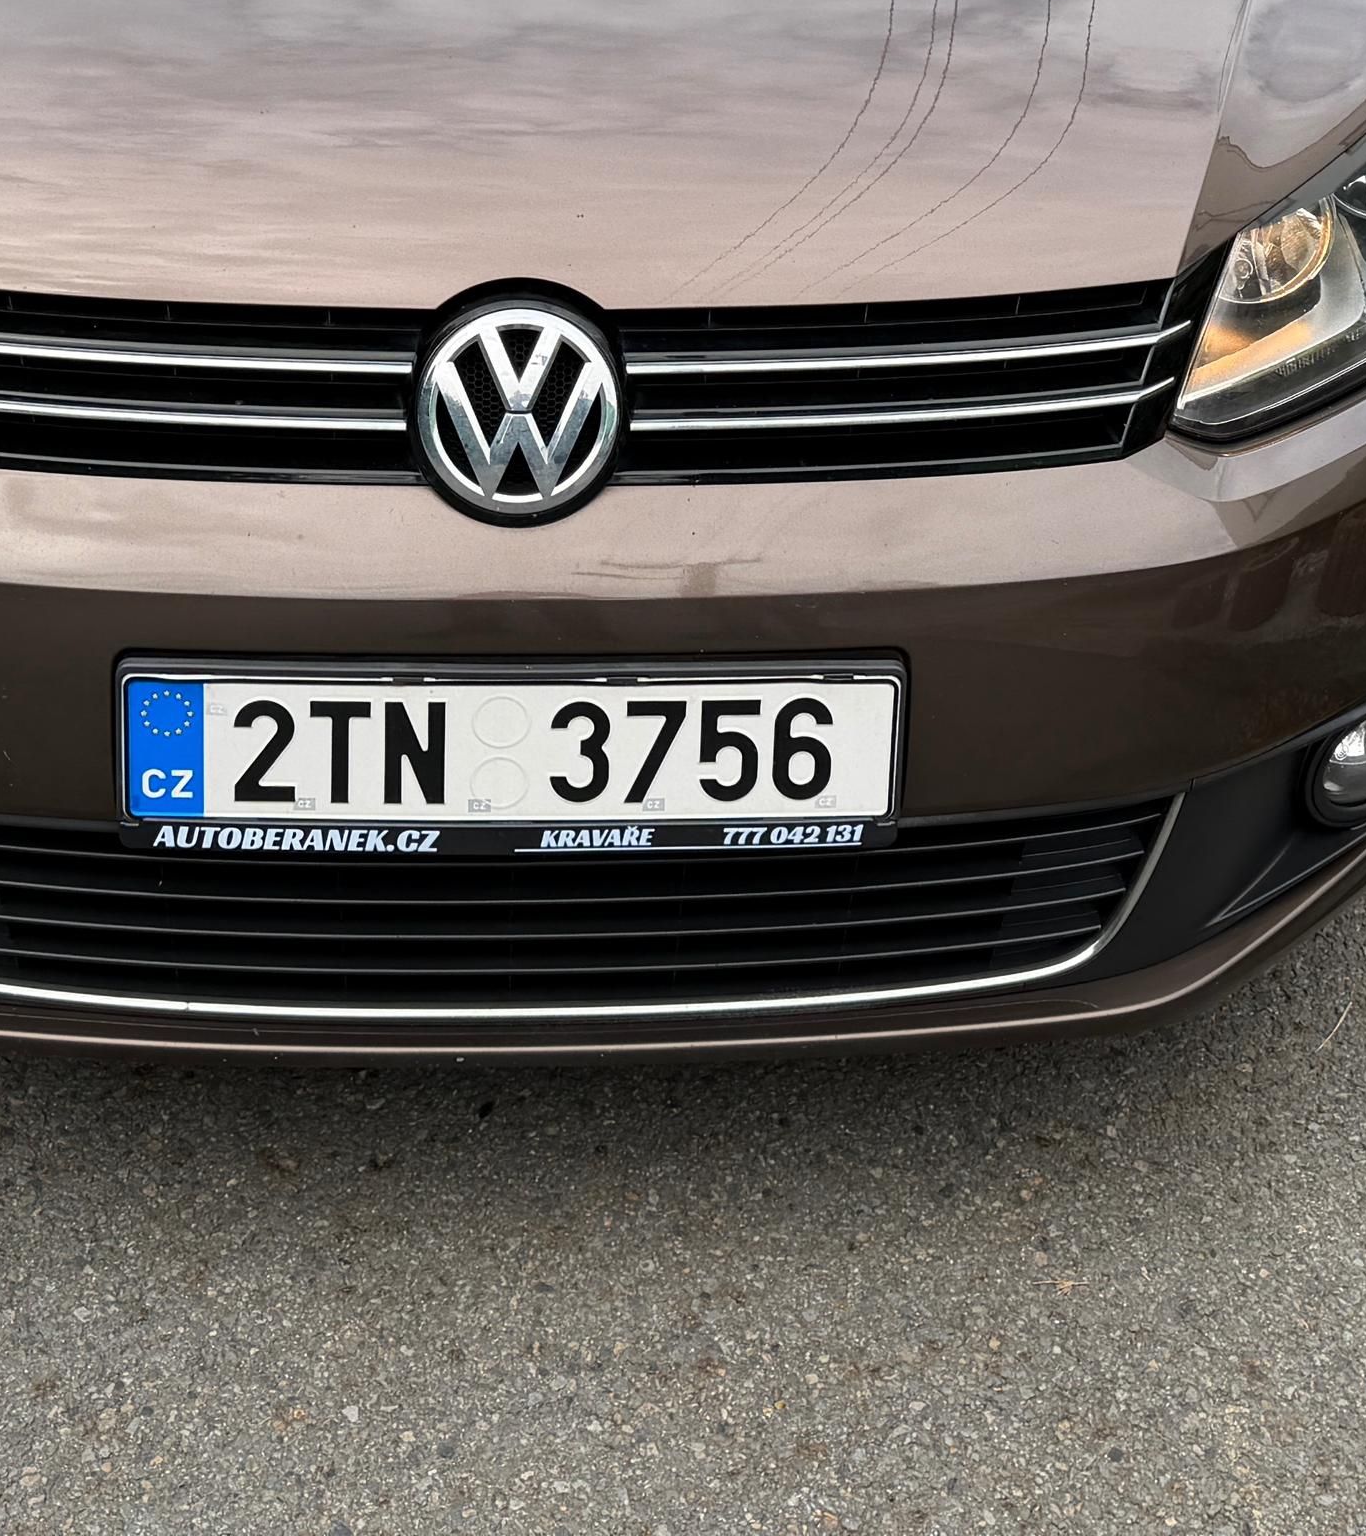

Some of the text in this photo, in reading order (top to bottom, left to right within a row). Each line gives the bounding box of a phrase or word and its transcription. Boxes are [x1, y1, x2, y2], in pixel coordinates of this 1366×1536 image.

[425, 314, 610, 509] VW
[233, 697, 834, 804] 2TN 3756
[141, 768, 194, 799] CZ
[152, 825, 441, 853] AUTOBERANEK.CZ
[540, 824, 864, 848] KRAVAŘE 777 042 131
